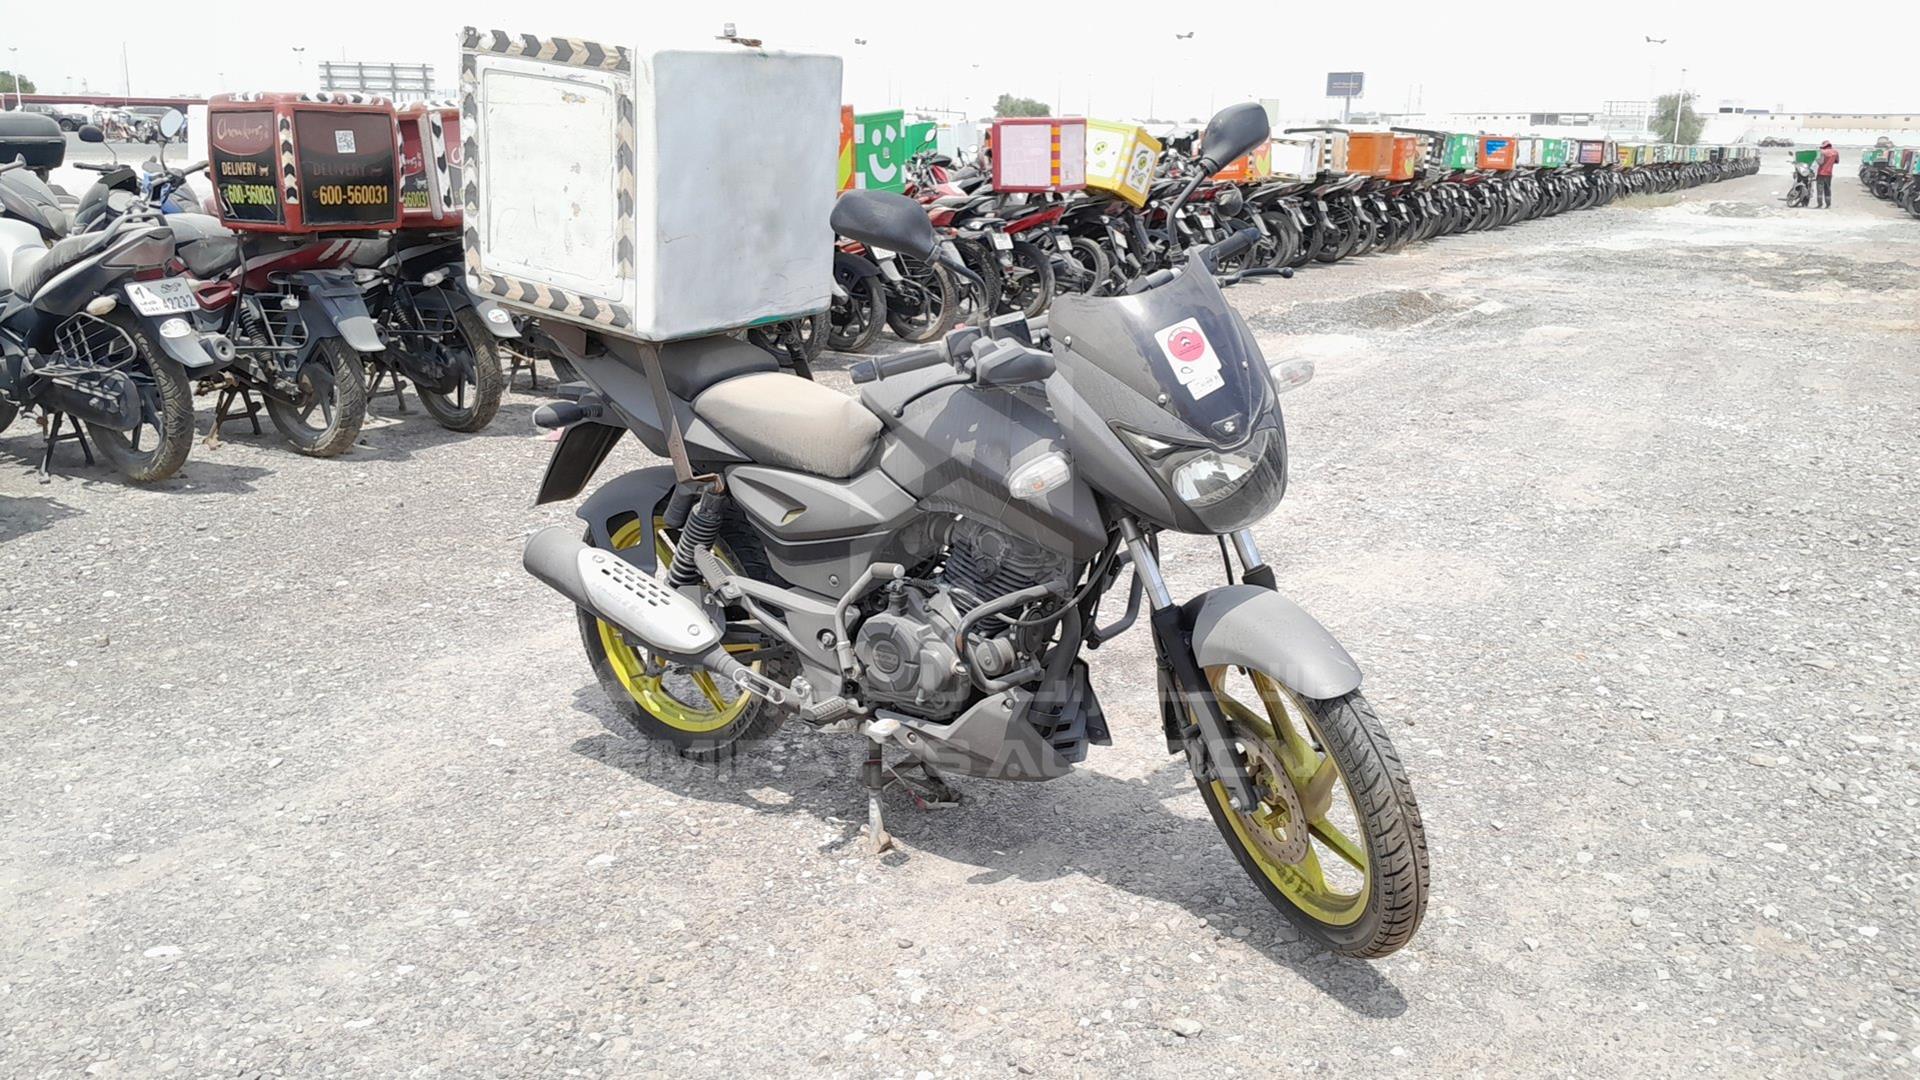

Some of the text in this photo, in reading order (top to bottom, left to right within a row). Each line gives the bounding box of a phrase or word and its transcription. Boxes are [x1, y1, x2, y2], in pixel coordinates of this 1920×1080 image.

[221, 161, 257, 176] DELIVERY
[227, 184, 277, 205] 600-560031
[319, 185, 388, 205] 600-560031
